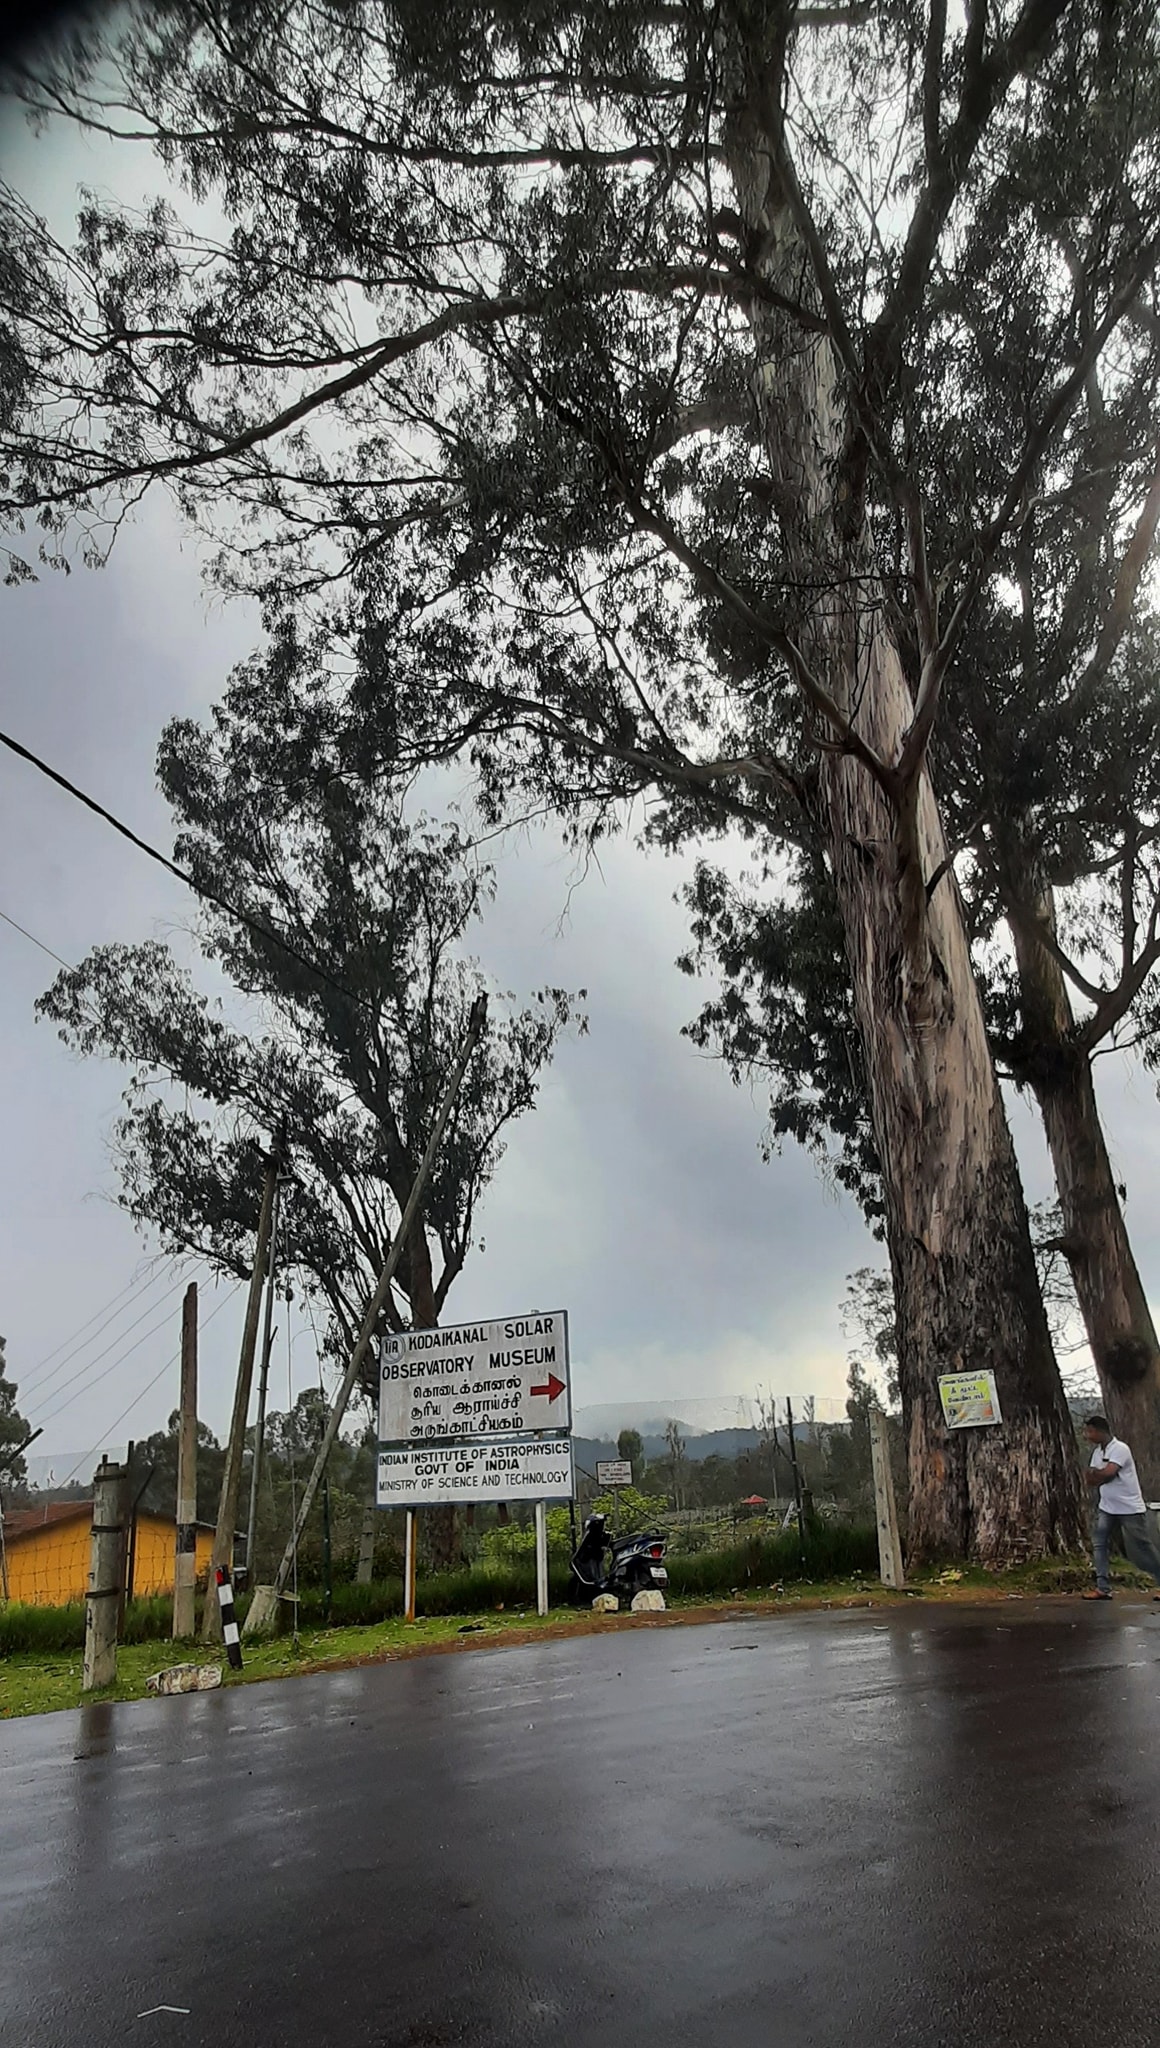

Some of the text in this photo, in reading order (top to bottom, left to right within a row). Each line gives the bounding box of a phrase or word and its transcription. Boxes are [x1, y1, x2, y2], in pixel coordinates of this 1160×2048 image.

[408, 1317, 554, 1351] KODAIKANAL SOLAR
[382, 1346, 556, 1381] OBSERVATORY MUSEUM
[413, 1374, 522, 1399] கொடைக்கானல்
[410, 1391, 522, 1420] சூரிய ஆராய்ச்சி
[379, 1442, 570, 1466] INDIAN INSTITUTE OF ASTROPHYSICS
[414, 1458, 520, 1476] GOVT OF INDIA
[379, 1471, 569, 1491] MINISTRY OF SCIENCE AND TECHNOLOGY
